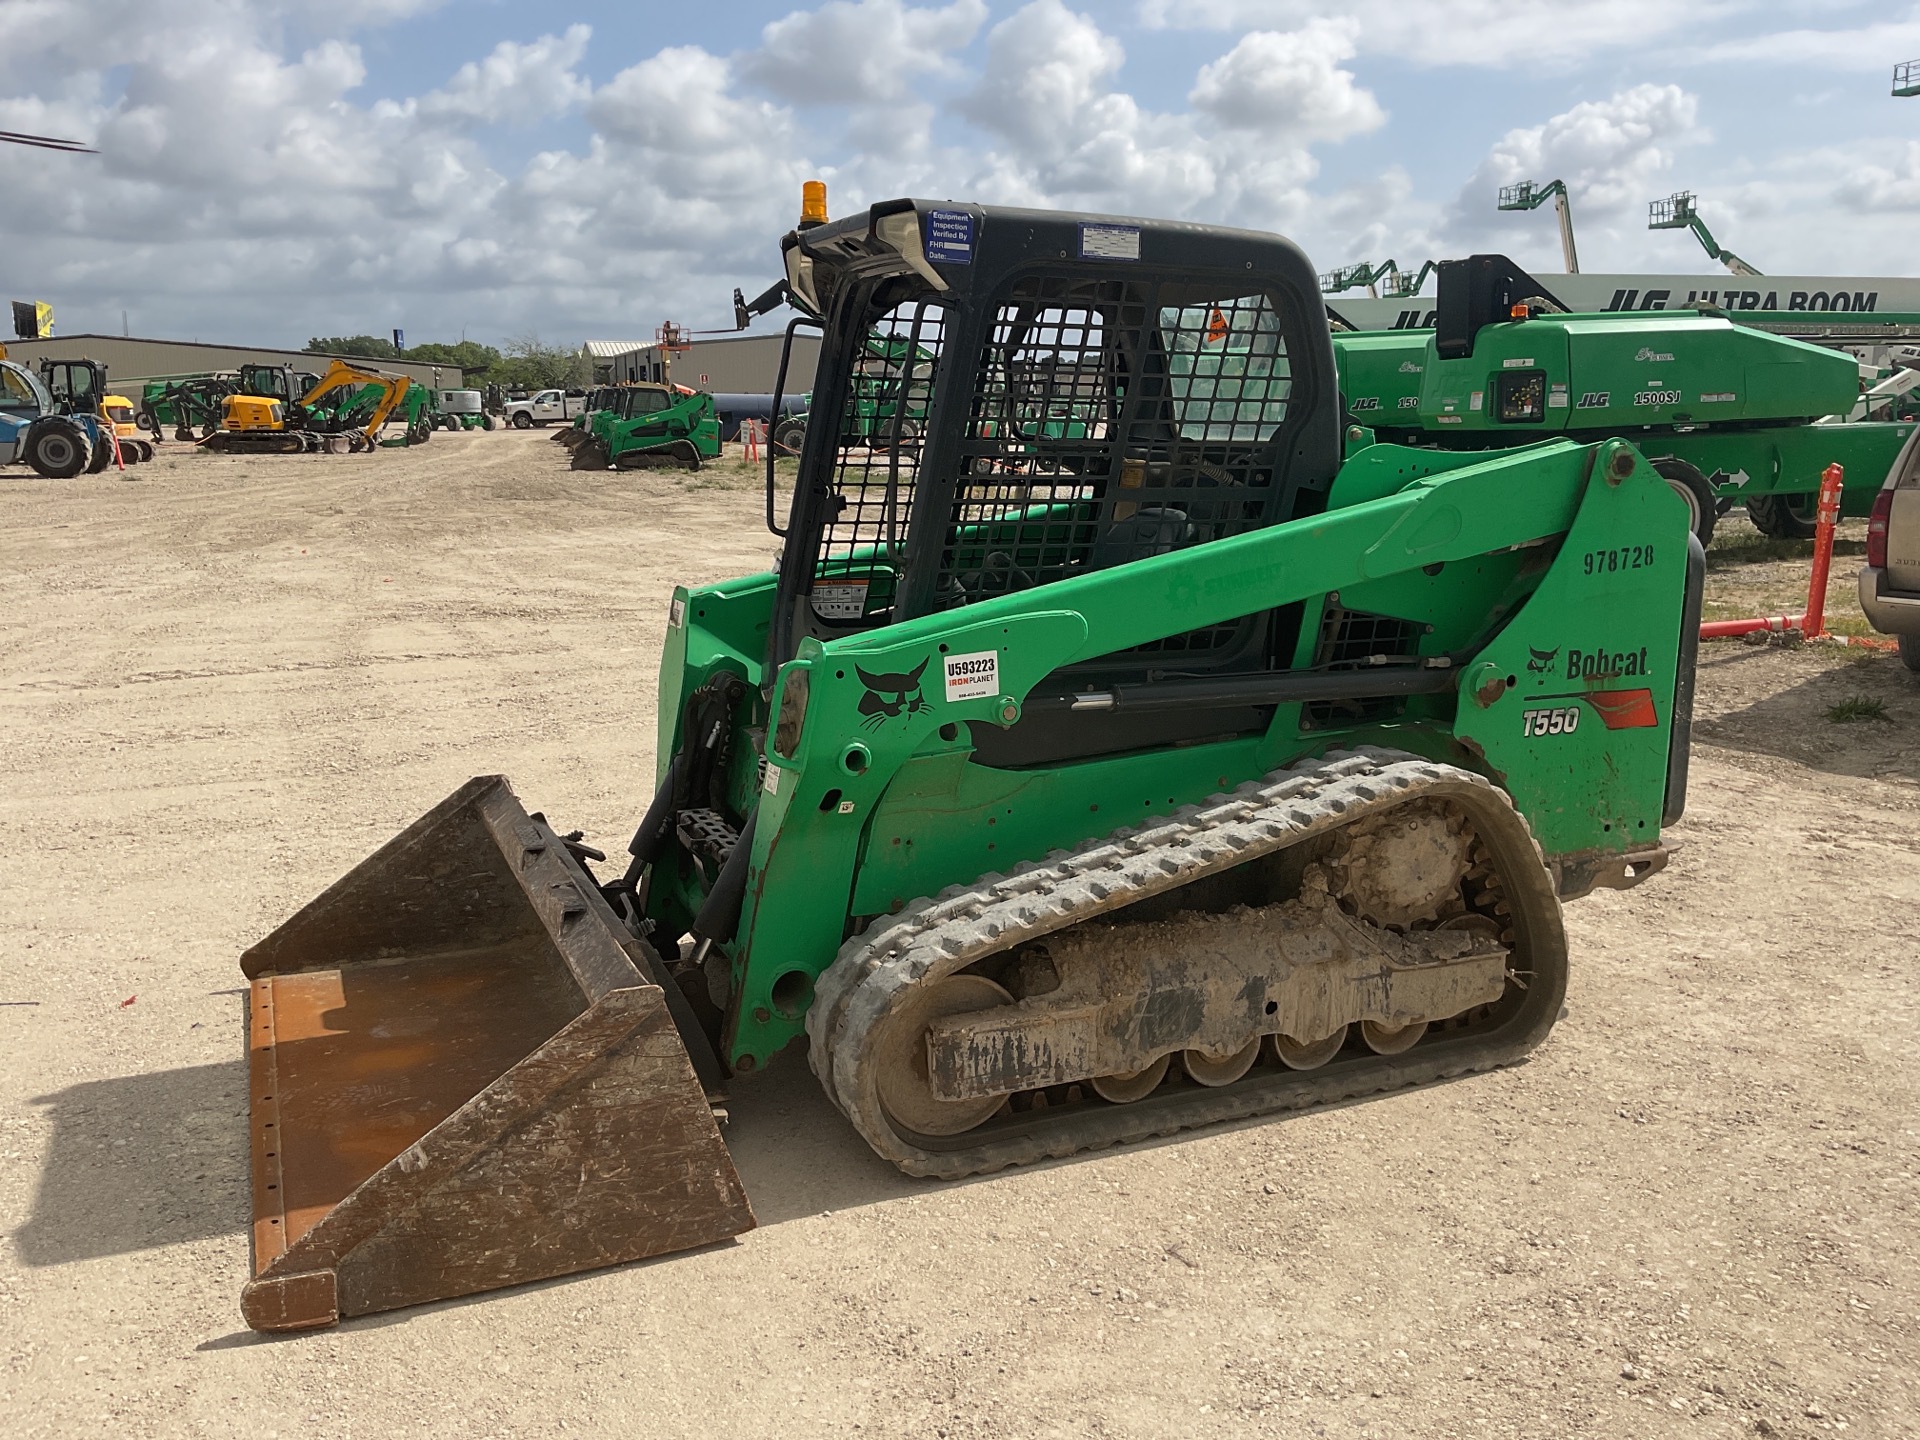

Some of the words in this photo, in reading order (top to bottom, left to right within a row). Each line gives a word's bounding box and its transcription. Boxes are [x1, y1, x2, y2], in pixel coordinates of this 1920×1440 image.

[933, 211, 968, 221] Equipment
[933, 221, 967, 230] Inspection
[932, 230, 957, 239] Verified
[959, 232, 967, 241] By
[929, 251, 946, 260] Date:
[1600, 289, 1670, 312] JLG
[1788, 291, 1878, 312] BOOM
[1350, 397, 1379, 411] JLG
[1577, 392, 1610, 409] JLG
[1634, 390, 1681, 406] 1500SJ
[1584, 544, 1654, 575] 978728
[948, 658, 994, 676] U593223
[1567, 647, 1648, 680] Bobcat
[1522, 706, 1580, 738] T550
